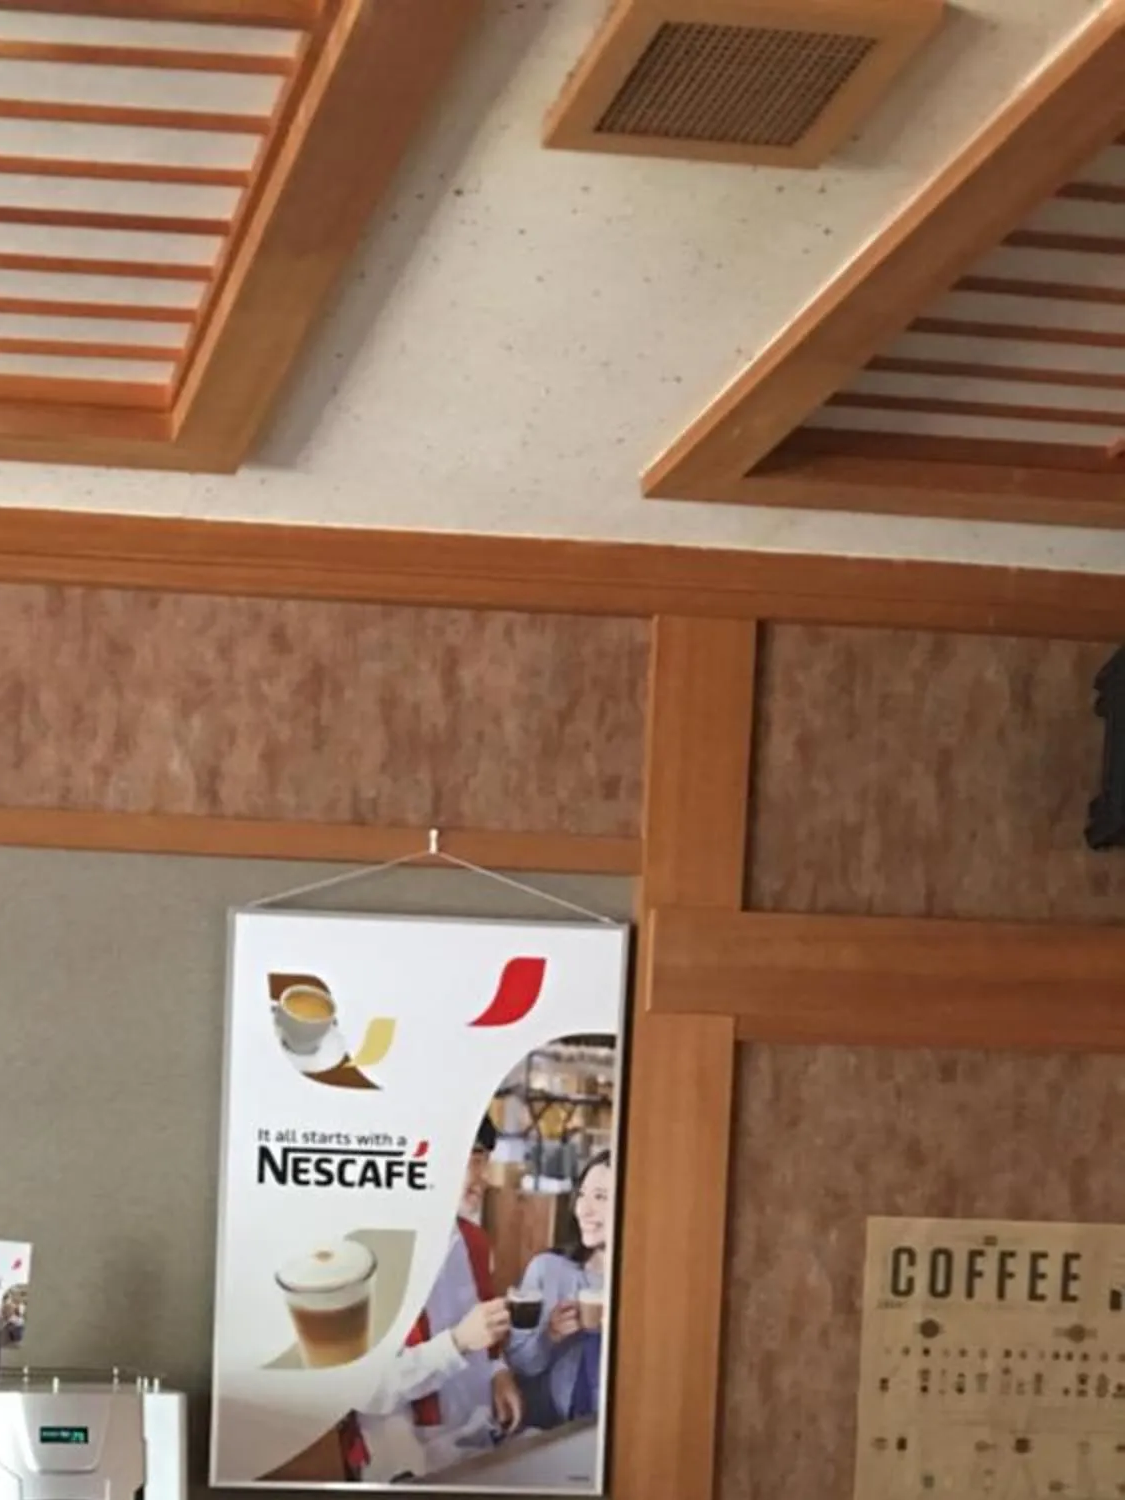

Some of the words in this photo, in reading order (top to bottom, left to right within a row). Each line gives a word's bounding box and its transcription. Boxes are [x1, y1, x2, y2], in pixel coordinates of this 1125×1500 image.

[257, 1128, 271, 1143] It
[275, 1129, 297, 1143] all
[302, 1130, 351, 1146] starts
[355, 1132, 393, 1147] with
[397, 1135, 408, 1147] a
[890, 1245, 1083, 1304] COFFEE
